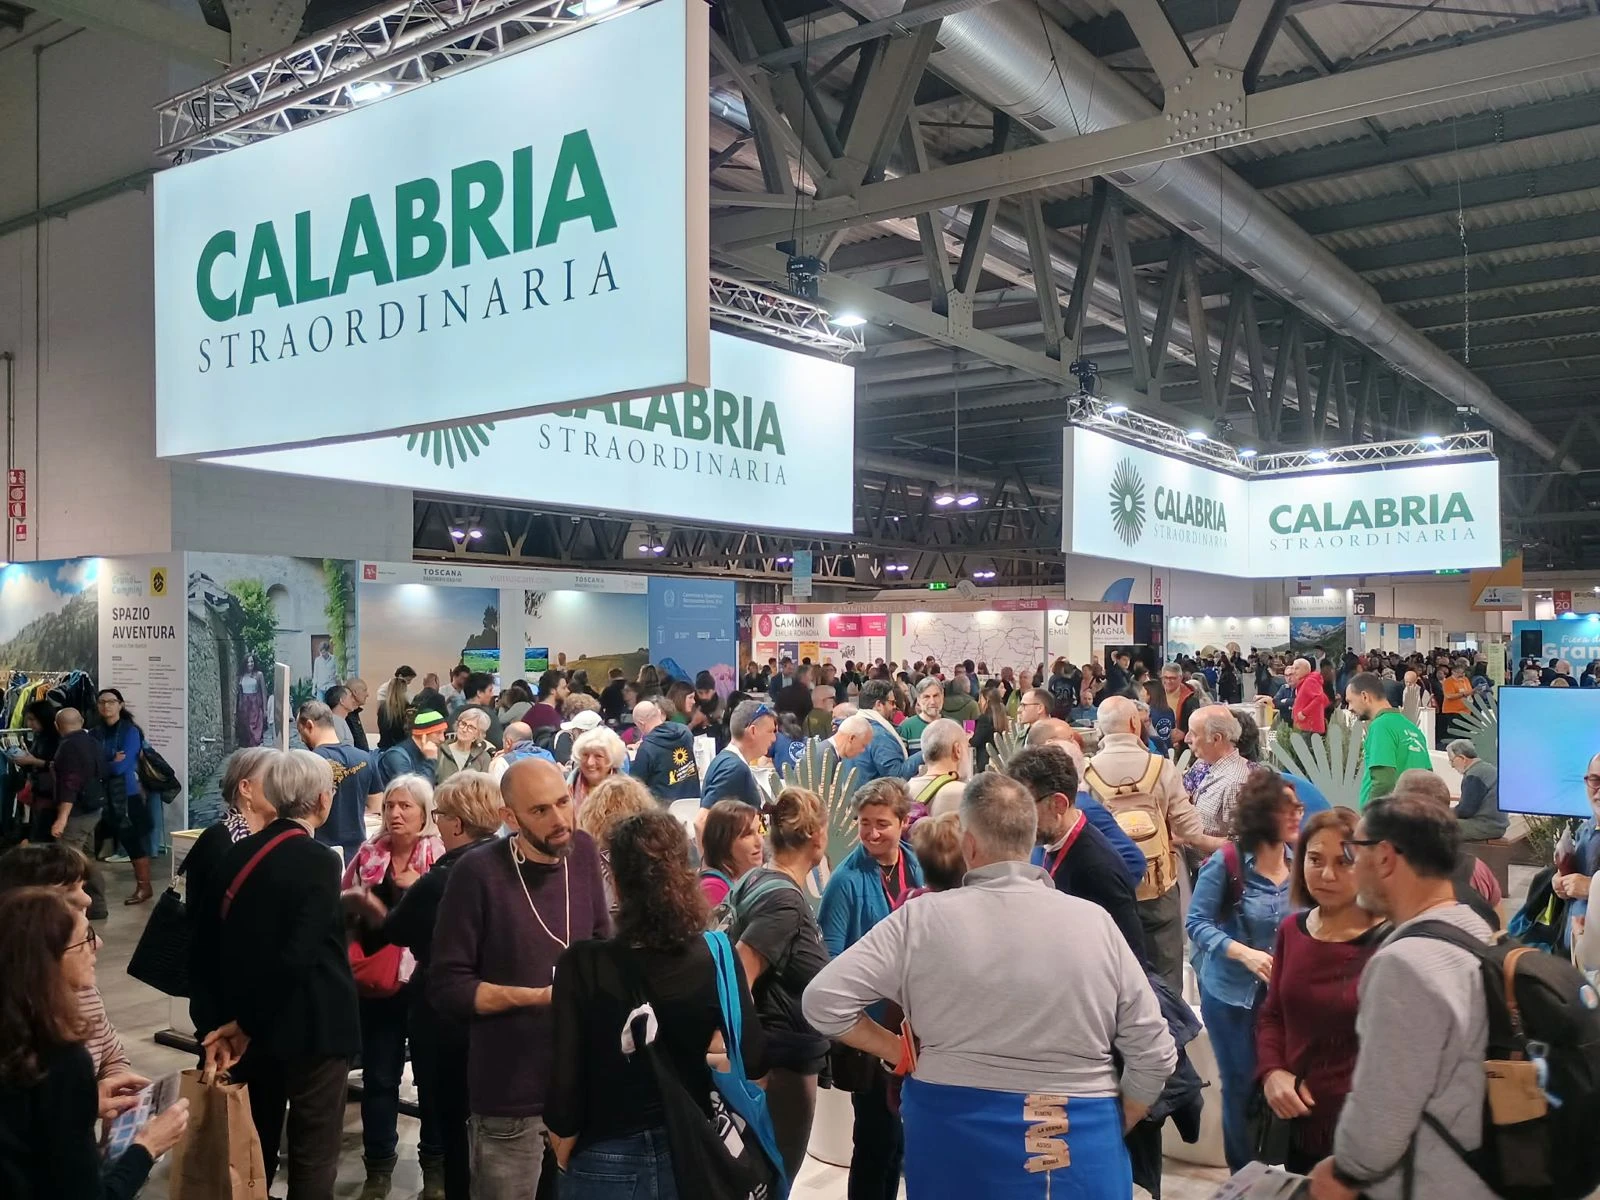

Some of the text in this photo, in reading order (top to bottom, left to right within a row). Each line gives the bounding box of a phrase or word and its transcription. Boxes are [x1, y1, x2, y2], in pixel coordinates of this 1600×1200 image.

[196, 128, 618, 322] CALABRIA
[198, 250, 621, 374] STRAORDINARIA
[553, 385, 787, 456] LABRIA
[538, 423, 788, 486] STRAORDINARIA
[1154, 486, 1228, 533] CALABRIA
[1268, 492, 1475, 535] CALABRIA
[1153, 525, 1228, 549] STRAORDINARIA
[1269, 526, 1477, 551] STRAORDINARIA
[423, 568, 463, 577] TOSCANA
[575, 576, 605, 584] TOSCANA
[112, 607, 150, 621] SPAZIO
[1352, 603, 1365, 614] 16
[1555, 601, 1570, 610] 20
[774, 616, 815, 628] CAMMINI
[1093, 627, 1126, 635] MAGNA
[112, 625, 176, 639] AVVENTURA
